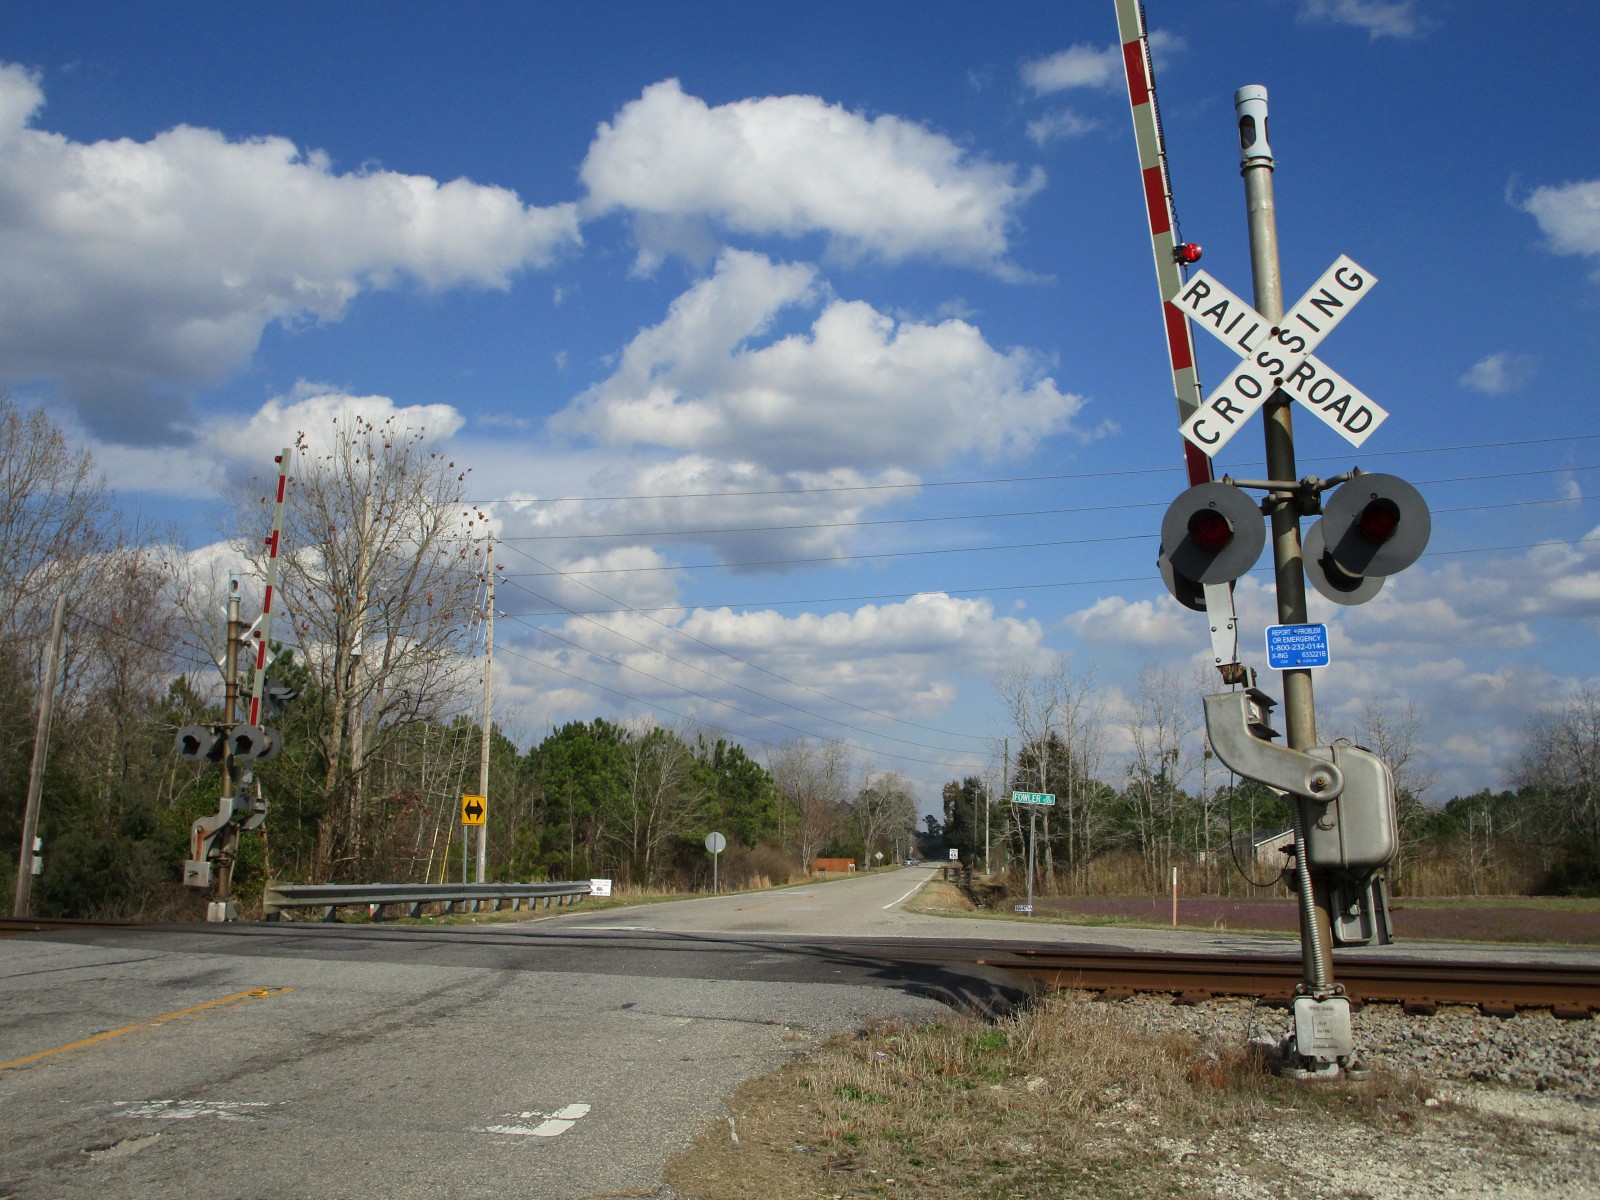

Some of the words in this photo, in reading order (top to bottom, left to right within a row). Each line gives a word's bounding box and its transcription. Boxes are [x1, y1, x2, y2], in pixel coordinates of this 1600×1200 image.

[1182, 279, 1259, 352] RAIL
[1286, 361, 1373, 433] ROAD
[1193, 267, 1363, 444] CROSSING
[1283, 635, 1321, 643] EMERGENCY
[1270, 643, 1325, 651] 1-800-232-0144
[1014, 793, 1041, 803] FOWLER
